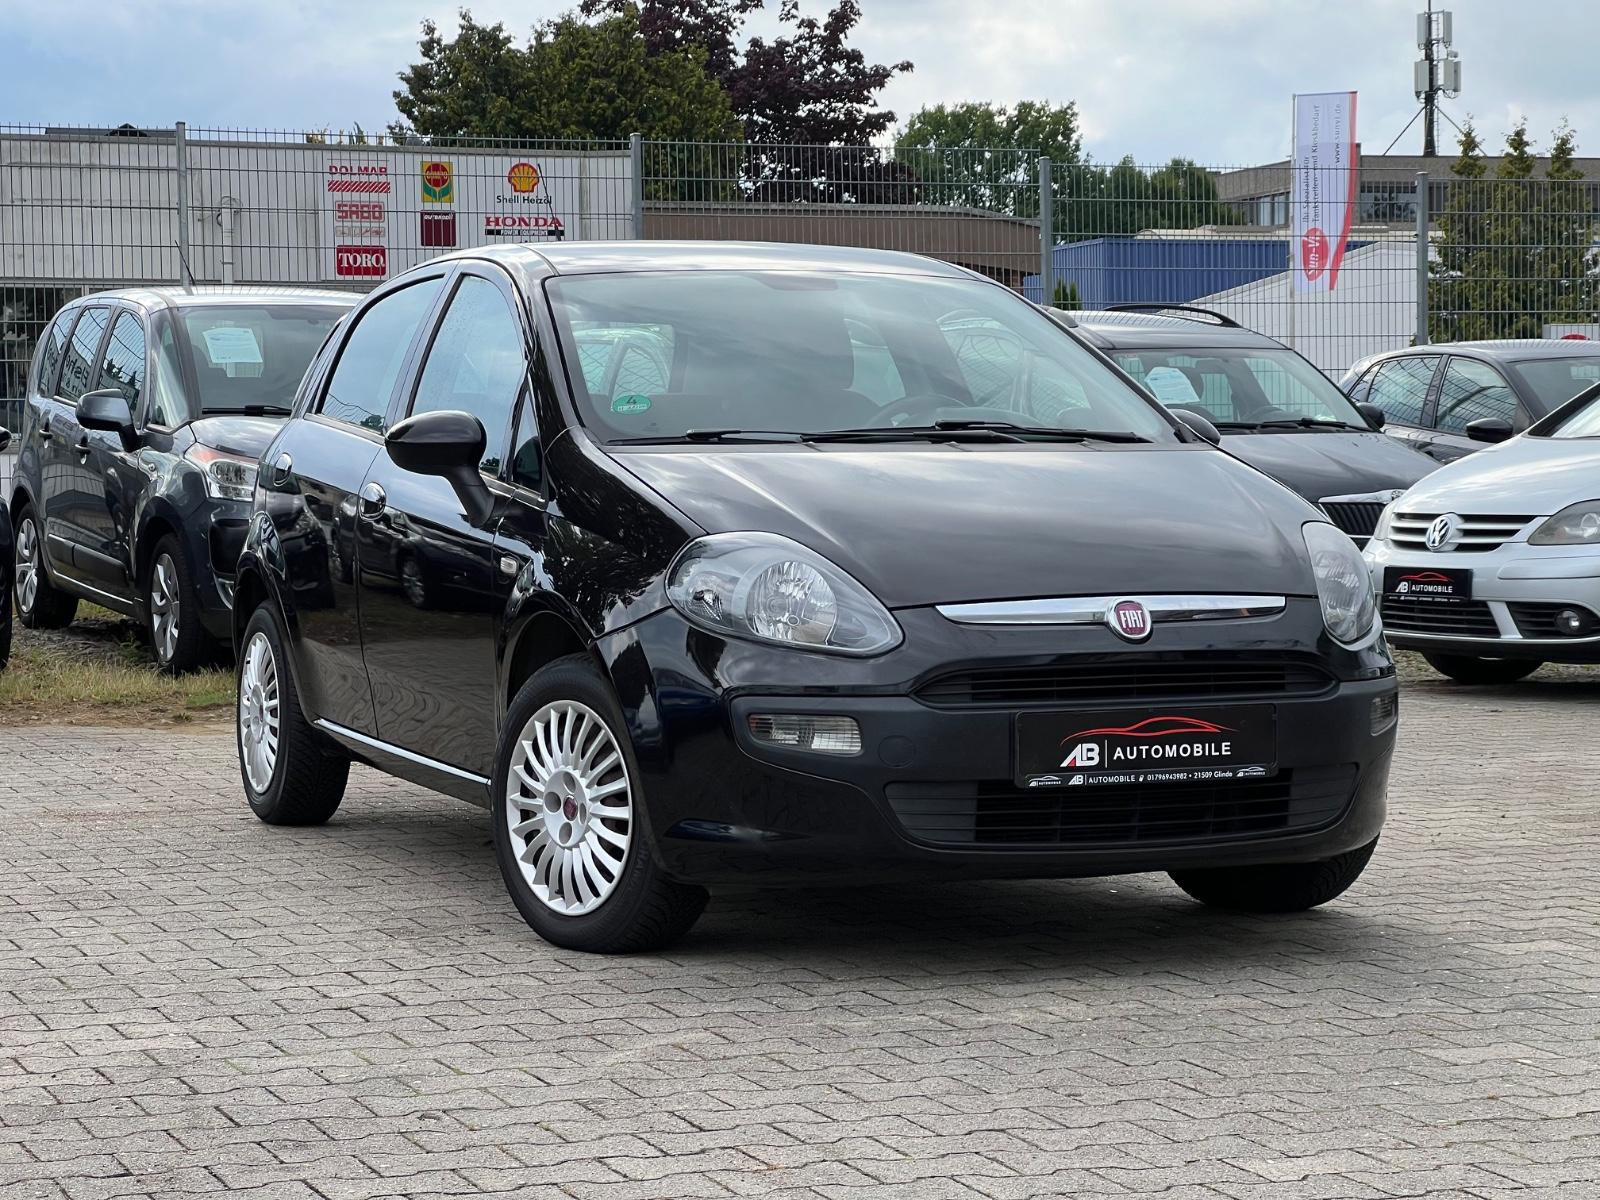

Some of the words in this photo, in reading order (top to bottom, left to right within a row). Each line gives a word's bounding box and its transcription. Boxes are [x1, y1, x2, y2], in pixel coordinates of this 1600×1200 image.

[329, 166, 388, 176] DOLMAR
[496, 194, 520, 204] Shell
[522, 195, 552, 204] Heizöl
[485, 216, 564, 227] HONDA
[338, 253, 385, 268] TORO
[626, 396, 637, 404] 4
[1395, 581, 1408, 592] AB
[1412, 584, 1453, 592] AUTOMOBILE
[1119, 610, 1144, 628] FIAT
[1060, 743, 1100, 768] AB
[1113, 742, 1232, 760] AUTOMOBILE
[1068, 775, 1084, 785] AB
[1088, 774, 1136, 784] AUTOMOBILE
